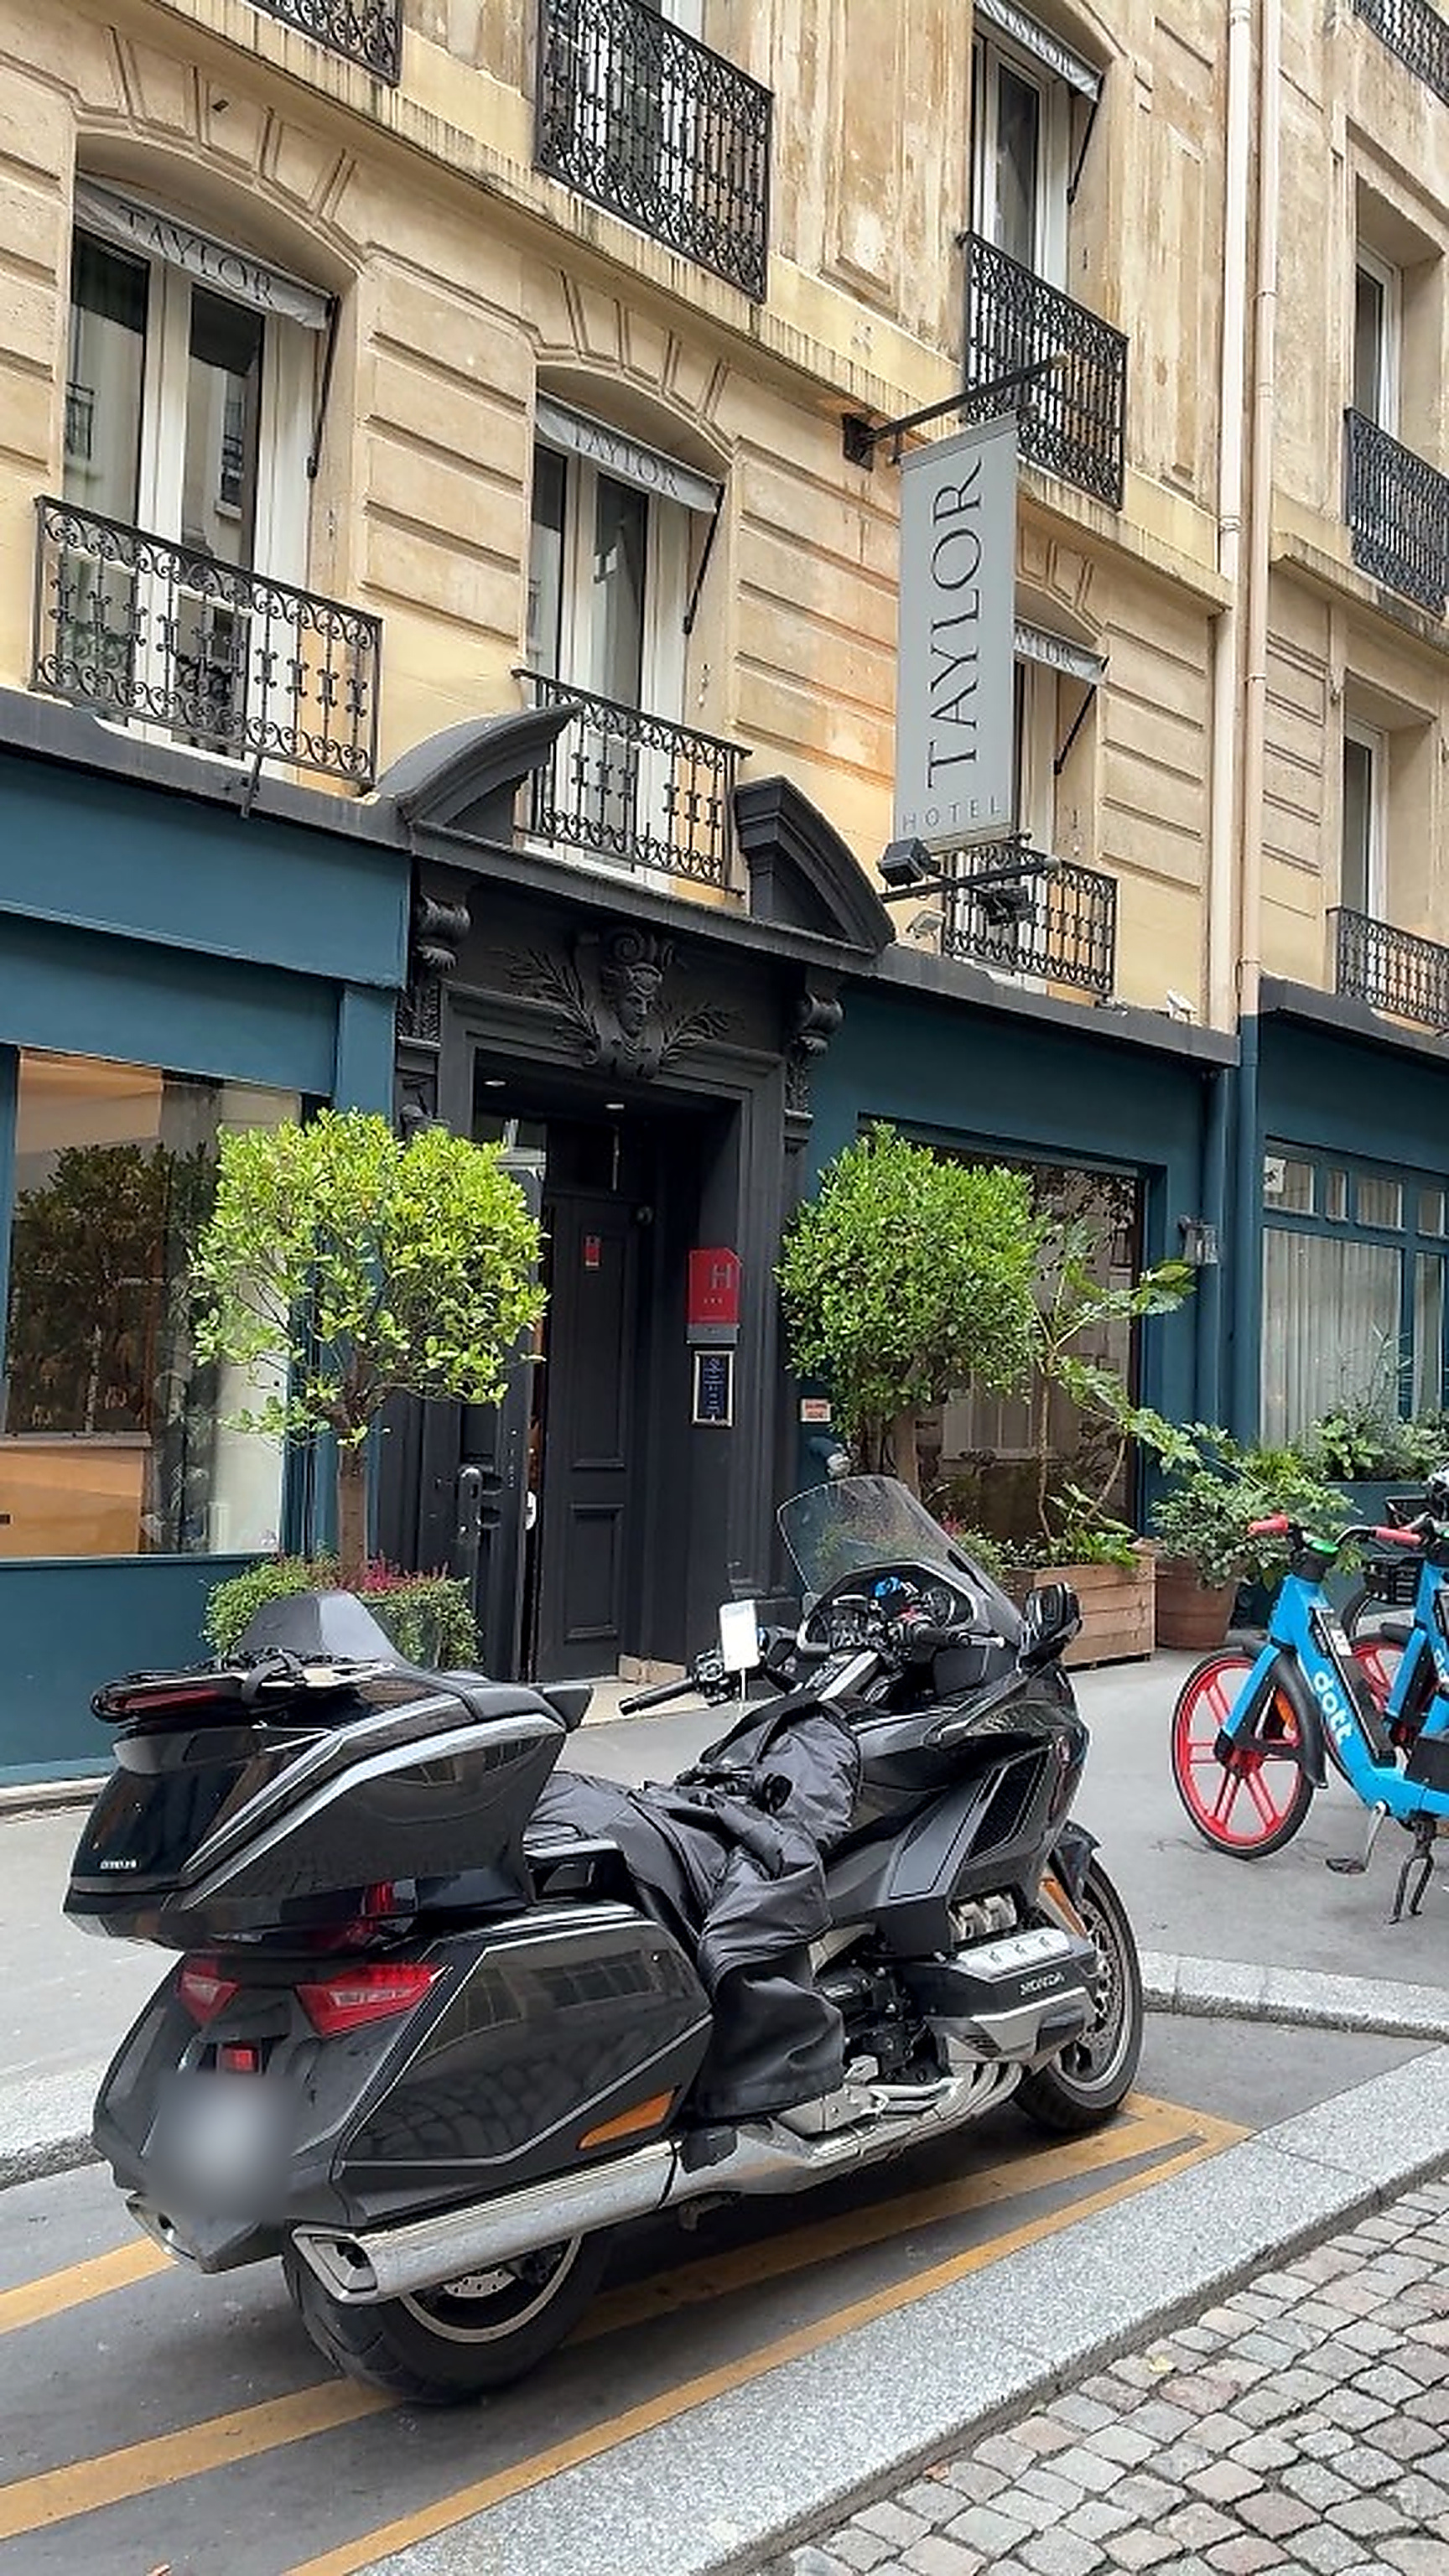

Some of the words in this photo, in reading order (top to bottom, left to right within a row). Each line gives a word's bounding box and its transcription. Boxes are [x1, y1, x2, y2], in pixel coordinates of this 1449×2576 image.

[119, 205, 274, 308] TAYLOR
[570, 423, 679, 497] TAYLOR
[928, 455, 983, 788] TAYLOR
[901, 795, 1002, 833] HOTEL
[711, 1263, 732, 1290] H
[1313, 1670, 1353, 1745] dott
